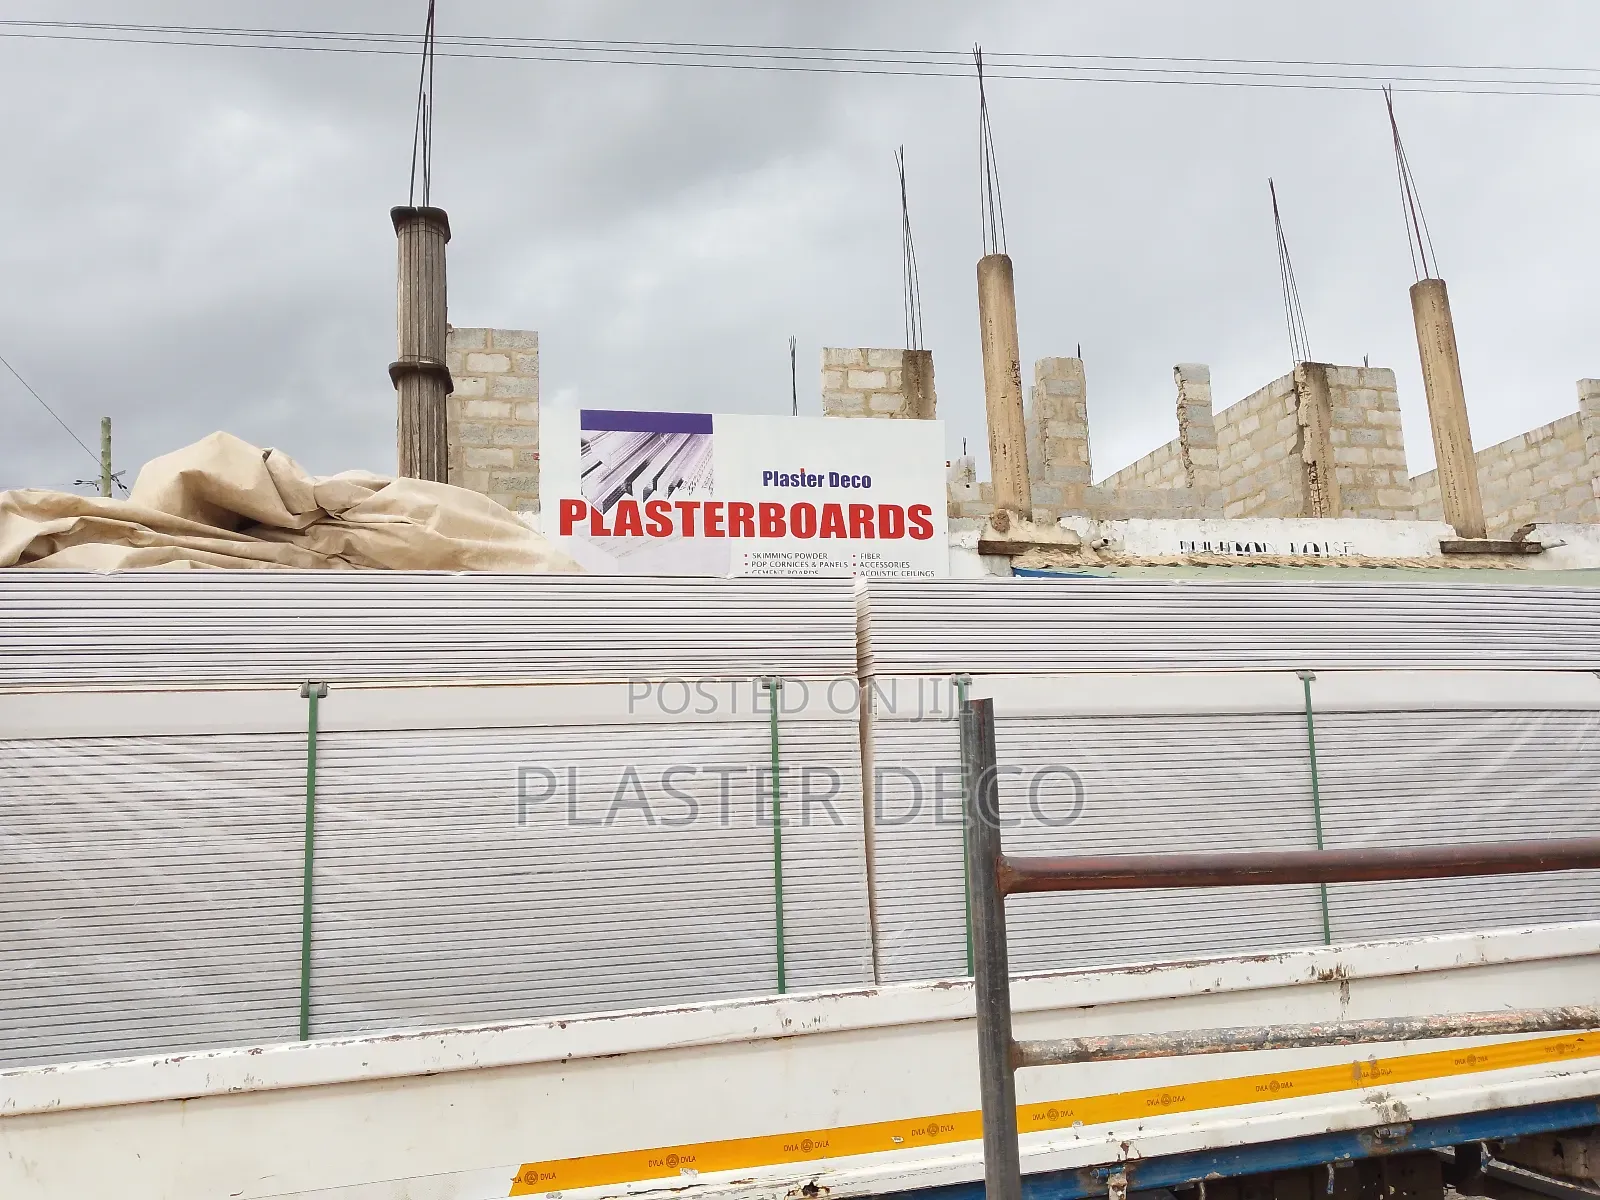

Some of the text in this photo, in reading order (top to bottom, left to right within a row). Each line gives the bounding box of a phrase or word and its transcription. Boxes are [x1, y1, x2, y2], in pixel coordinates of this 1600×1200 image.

[762, 469, 872, 489] Plaster Deco
[559, 498, 934, 541] PLASTERBOARDS
[752, 552, 828, 560] SKIMMING POWDER
[819, 561, 848, 569] PANELS
[860, 561, 910, 569] ACCESSORIES
[1255, 1081, 1294, 1093] DVLA DVLA
[1146, 1095, 1186, 1107] DVLA DVLA
[1032, 1109, 1074, 1121] DVLA DVLA
[911, 1124, 955, 1137] DVLA DVLA
[783, 1140, 830, 1153] DVLA DVLA
[648, 1154, 697, 1169] DVLA DVLA
[540, 1172, 557, 1181] DVLA
